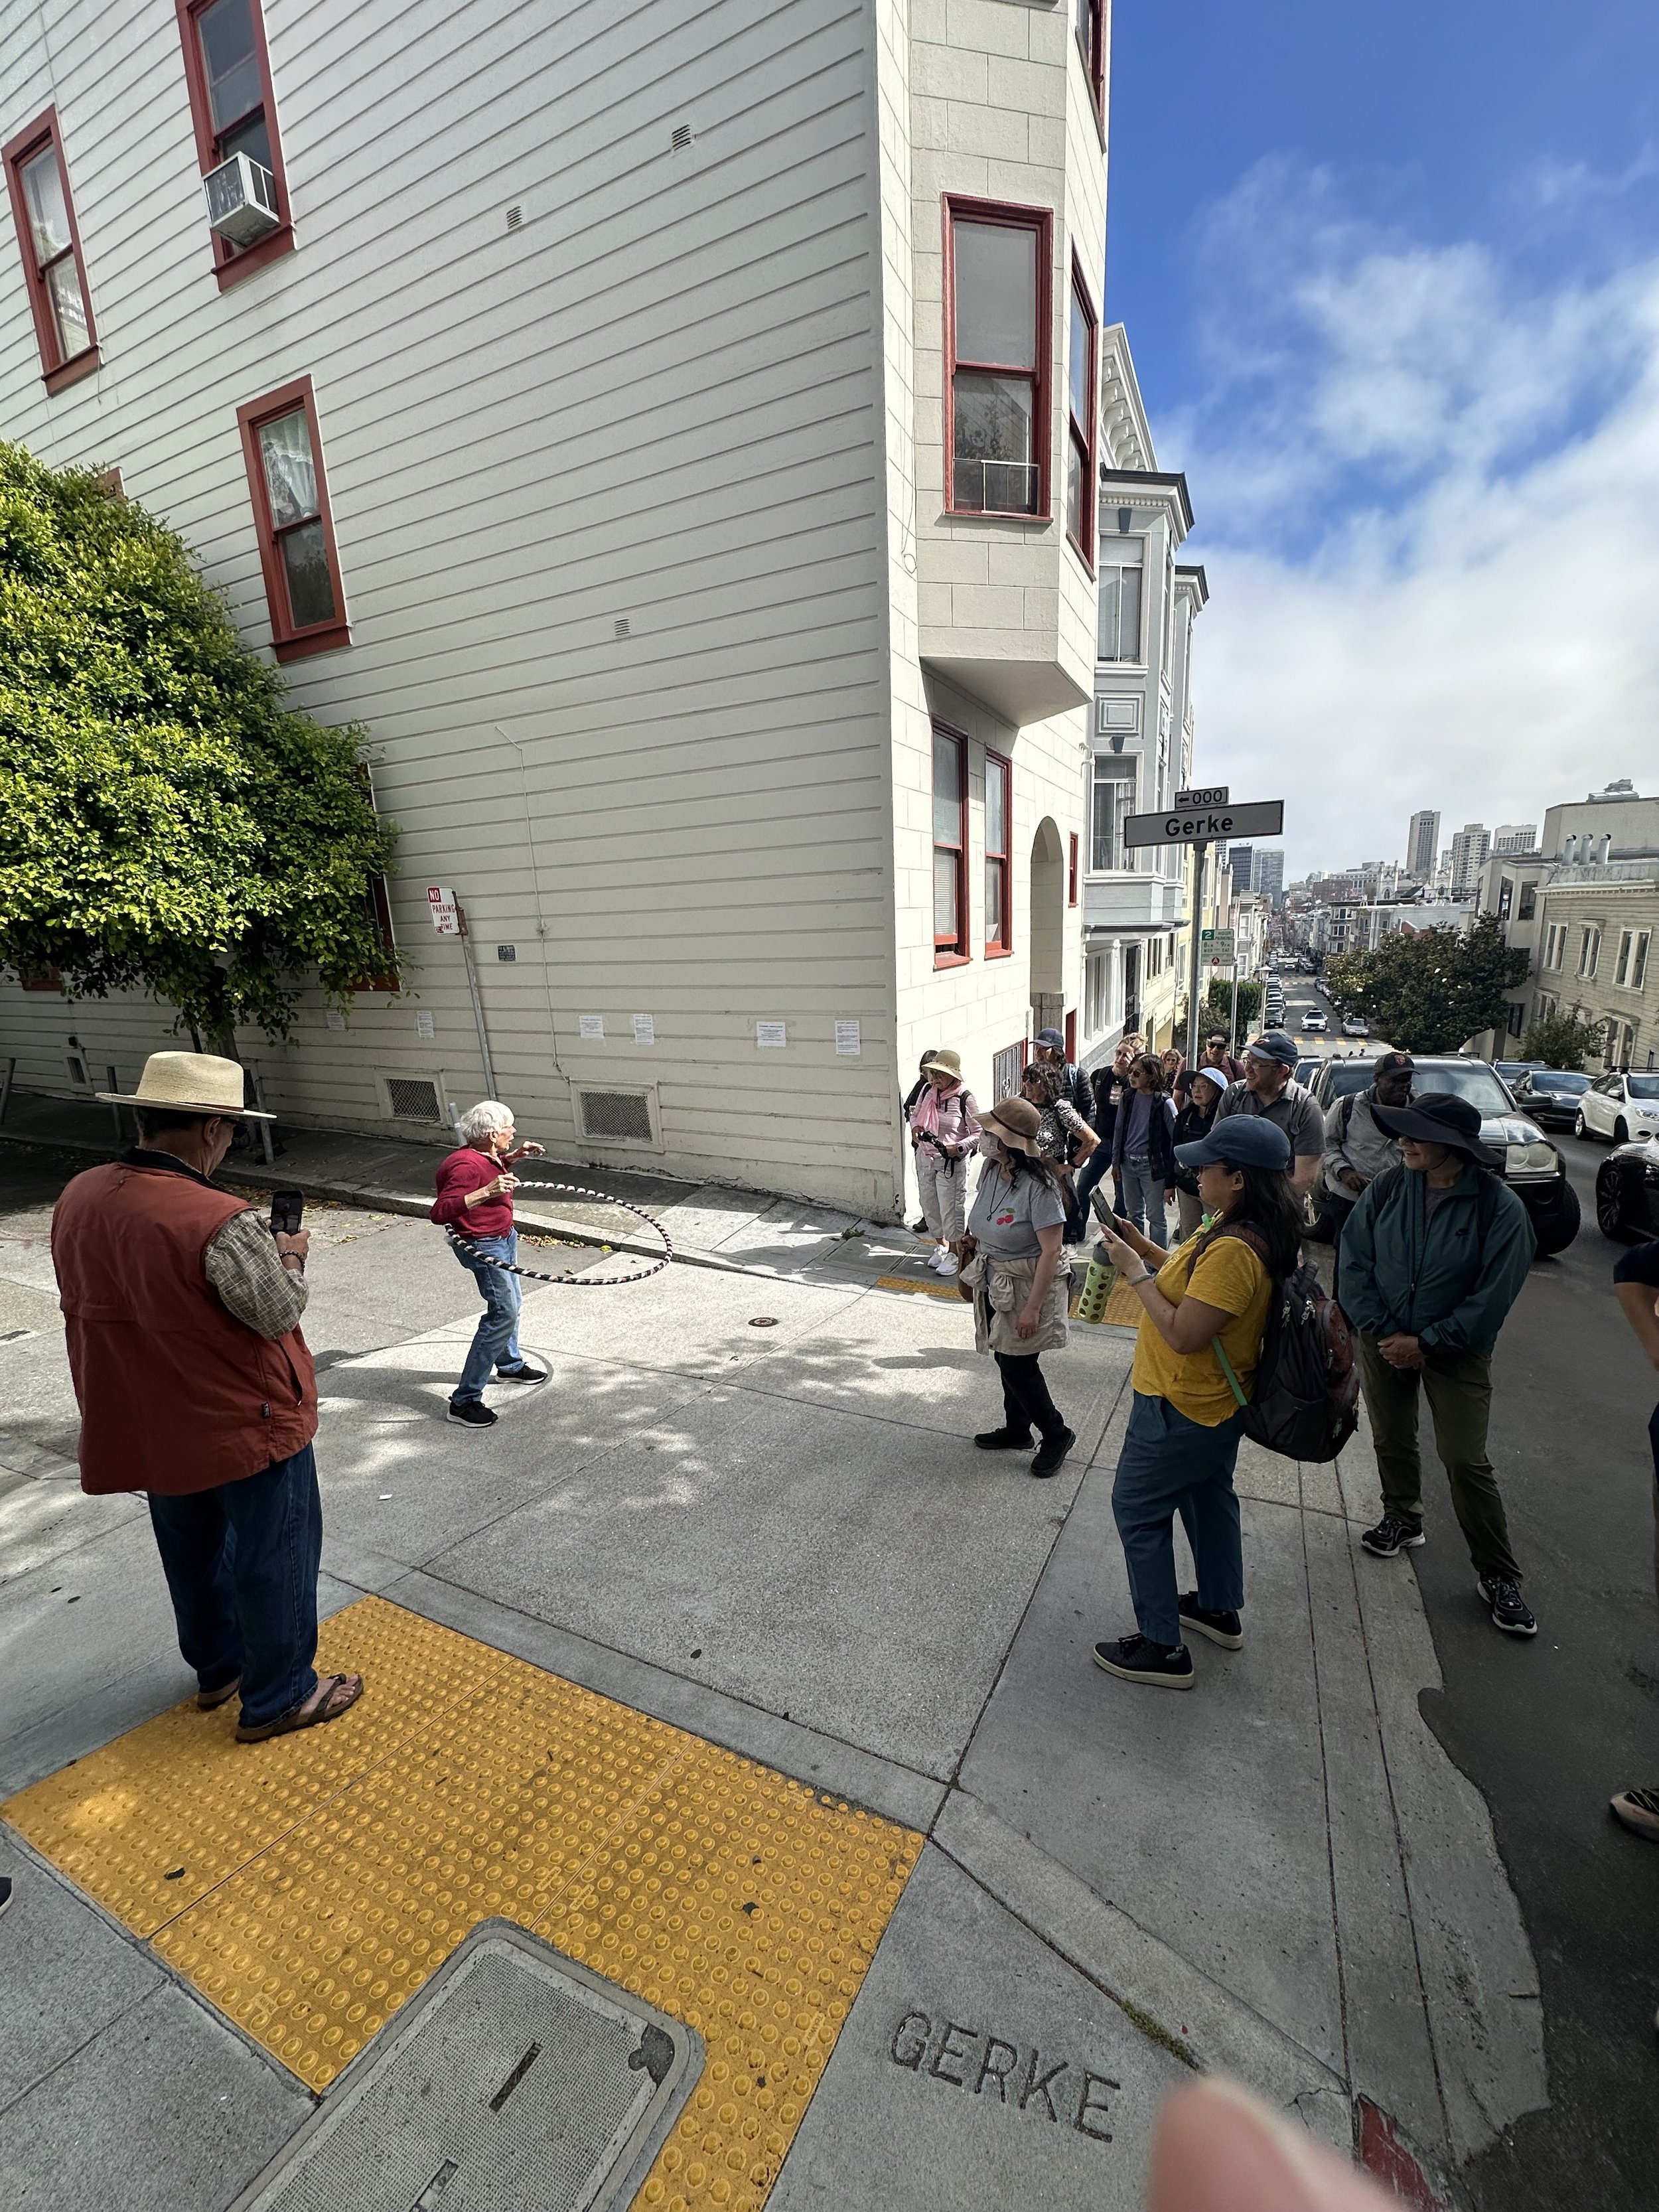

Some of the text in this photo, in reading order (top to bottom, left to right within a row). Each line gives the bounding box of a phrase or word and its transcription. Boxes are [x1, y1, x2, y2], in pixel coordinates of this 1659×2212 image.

[1192, 790, 1222, 804] 000
[1165, 814, 1234, 837] Gerke
[429, 890, 439, 901] NO
[432, 904, 455, 914] PARKING
[1204, 930, 1212, 939] 2
[891, 2011, 1121, 2144] GERKE
